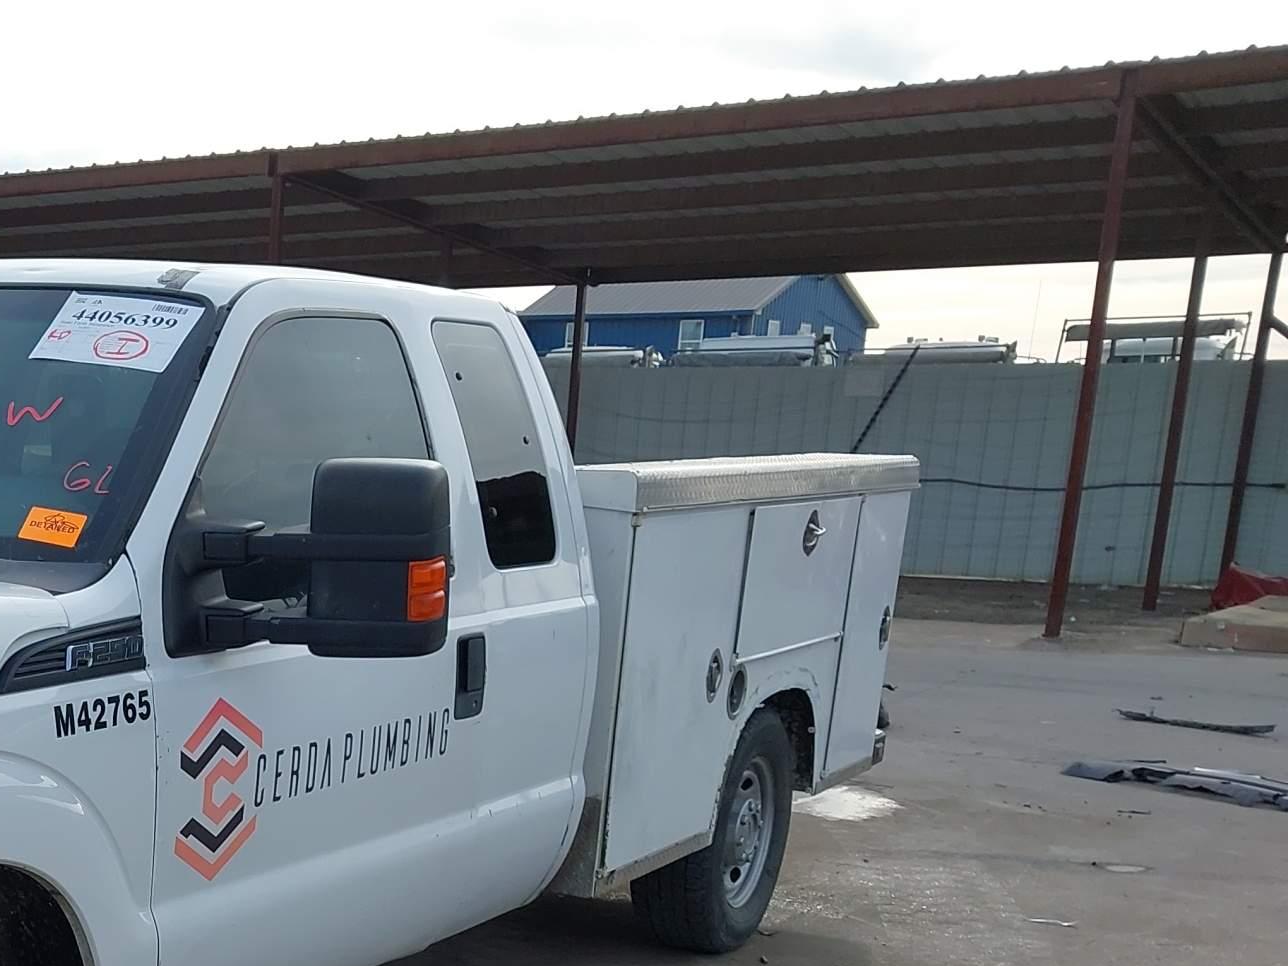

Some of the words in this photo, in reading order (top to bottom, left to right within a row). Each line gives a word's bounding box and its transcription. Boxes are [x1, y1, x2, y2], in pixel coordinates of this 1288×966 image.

[72, 309, 178, 330] 44056399
[54, 689, 151, 738] M42765
[253, 737, 333, 808] CERDA
[340, 708, 450, 784] PLUMBING
